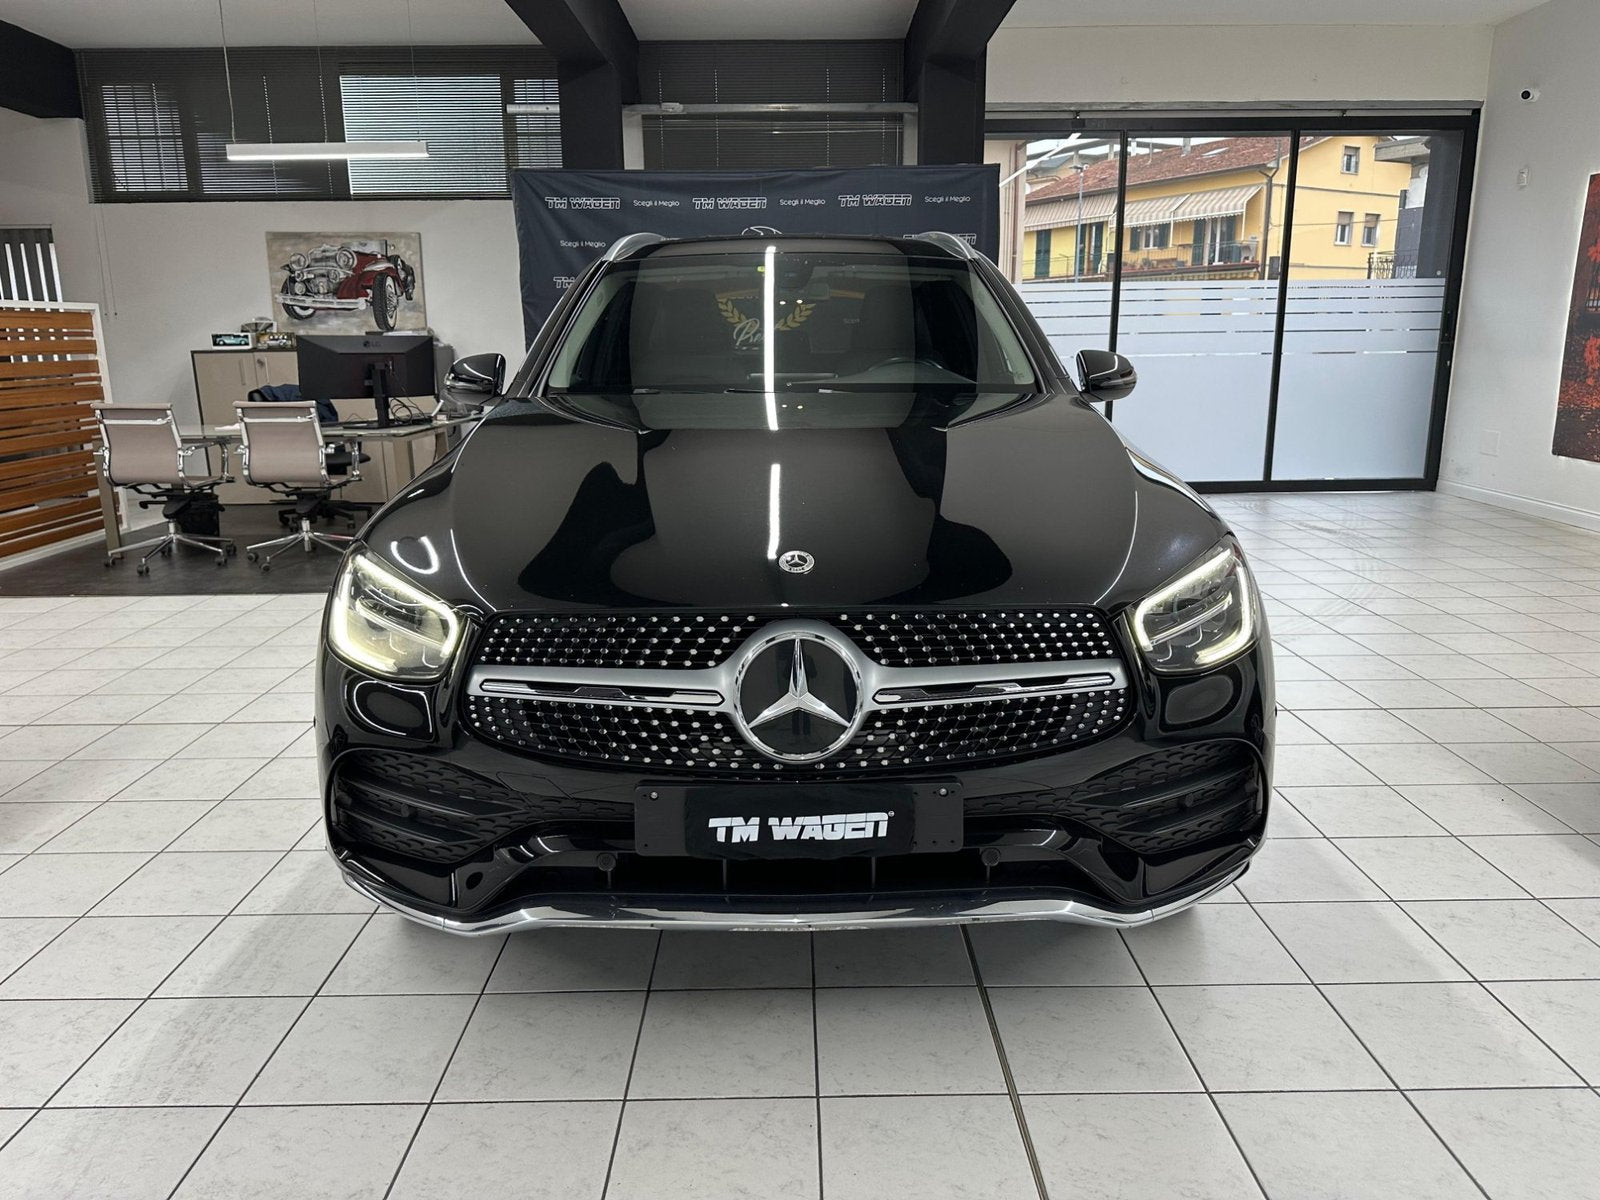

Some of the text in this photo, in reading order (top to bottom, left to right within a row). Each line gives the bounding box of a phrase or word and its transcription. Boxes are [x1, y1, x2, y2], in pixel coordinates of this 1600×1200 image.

[545, 196, 568, 210] TM
[658, 200, 680, 208] Meglio
[692, 197, 715, 210] TM
[804, 198, 826, 207] Meglio
[838, 194, 860, 207] TM
[949, 195, 971, 203] Meglio
[708, 816, 760, 843] TM
